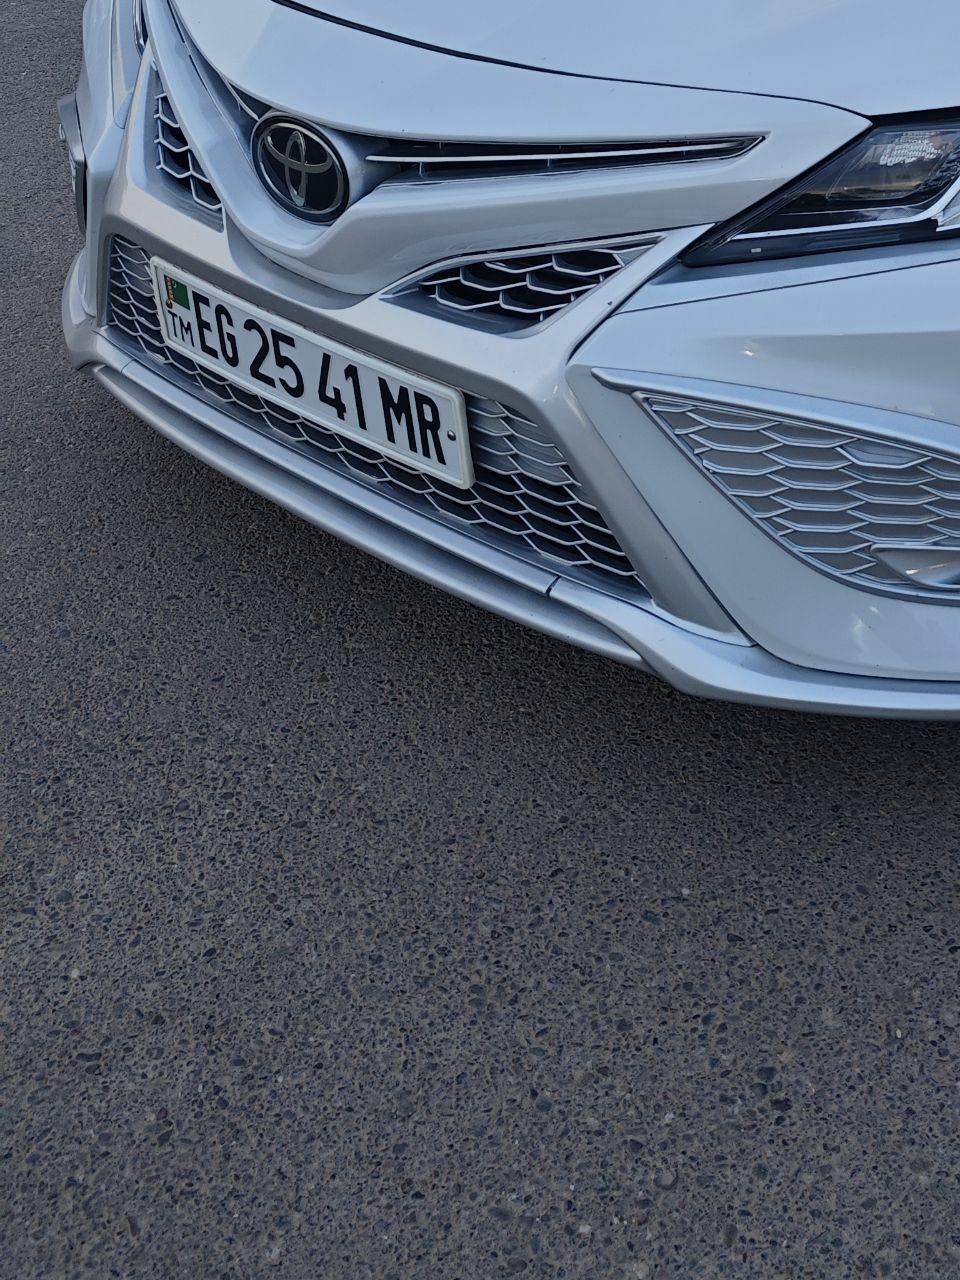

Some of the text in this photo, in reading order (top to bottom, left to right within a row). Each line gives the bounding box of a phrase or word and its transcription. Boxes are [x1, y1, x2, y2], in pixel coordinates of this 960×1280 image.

[167, 310, 195, 347] TM
[192, 290, 447, 465] EG 25 41 MR
